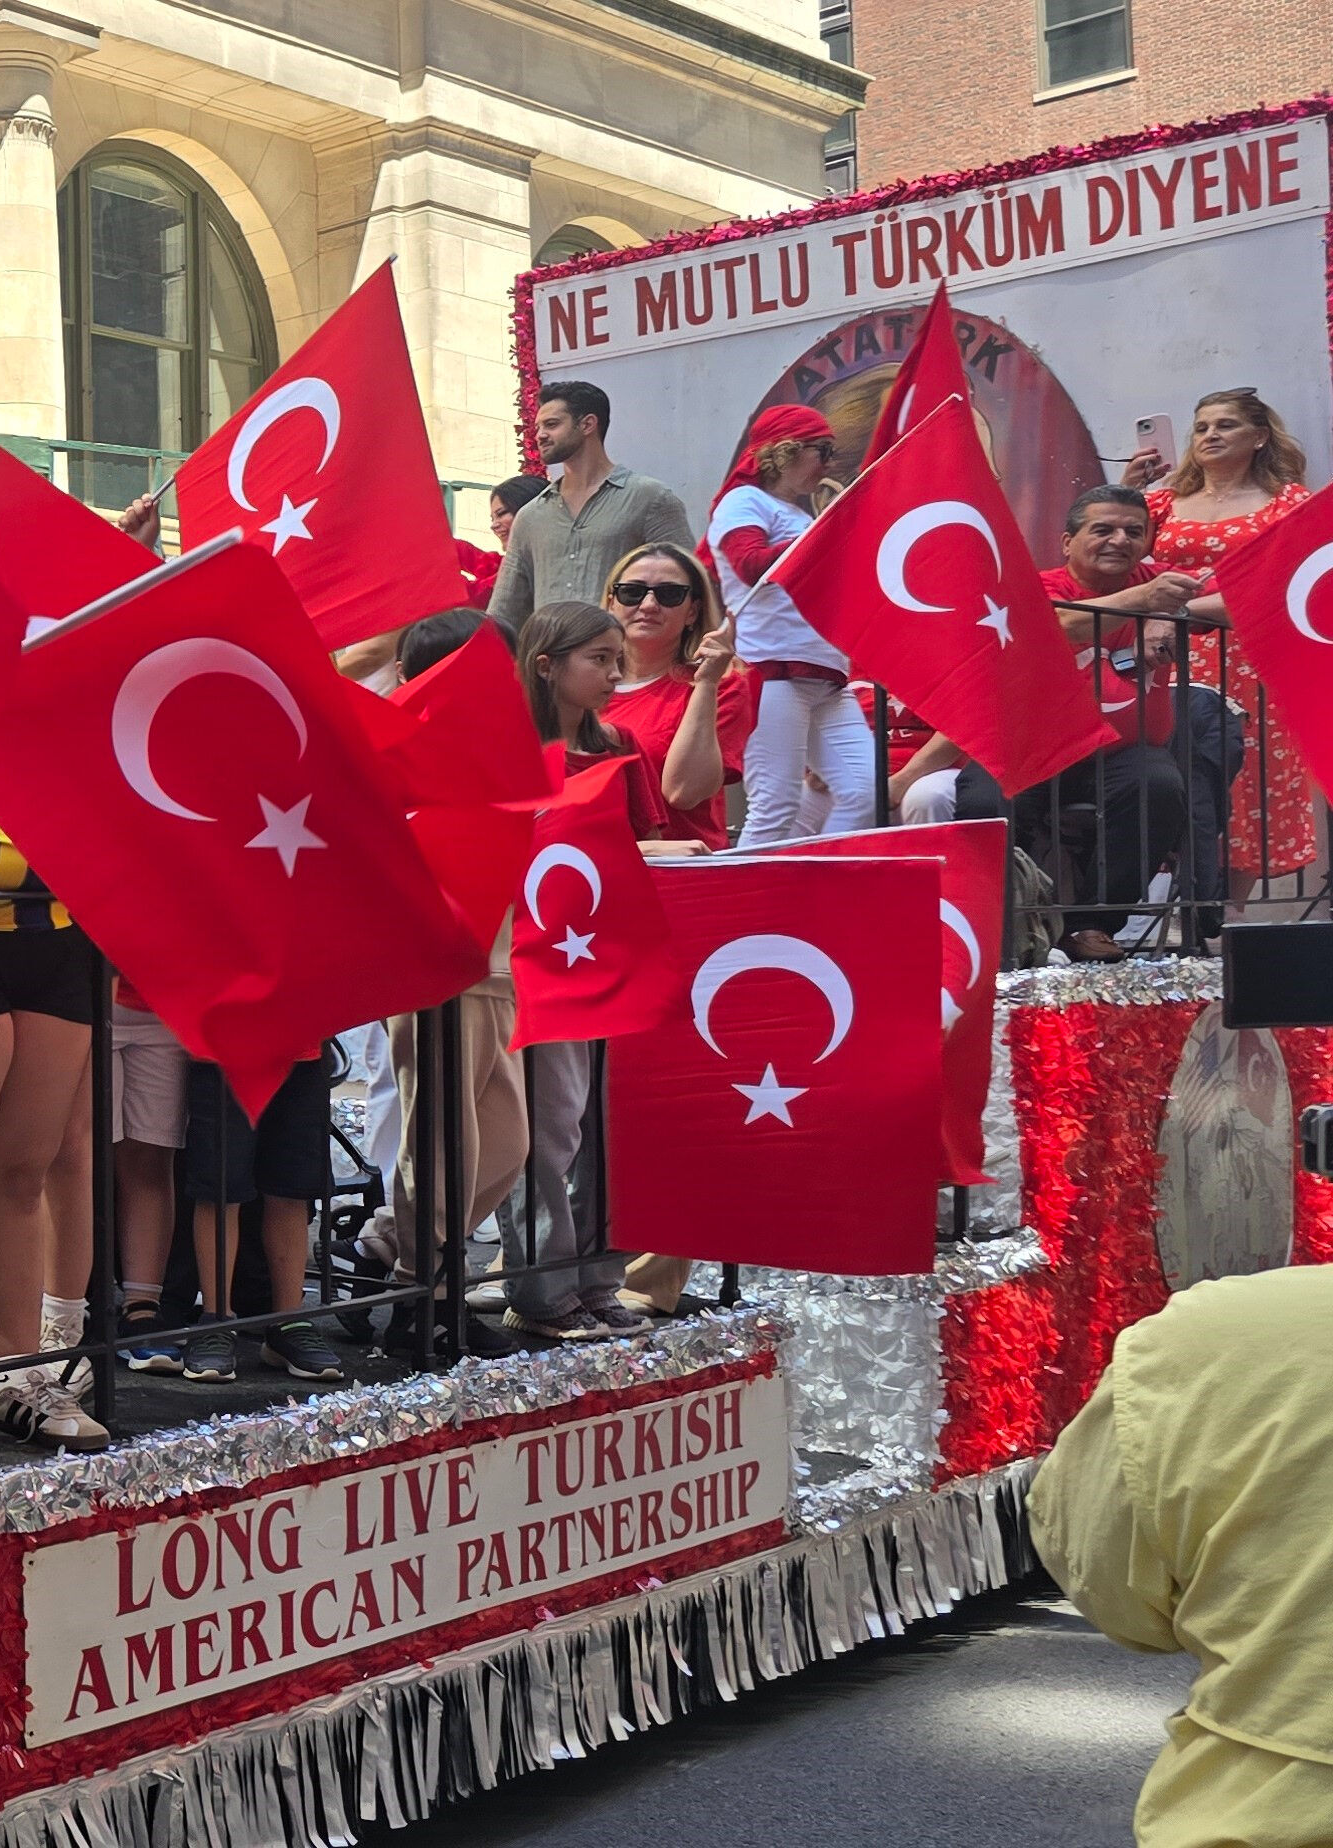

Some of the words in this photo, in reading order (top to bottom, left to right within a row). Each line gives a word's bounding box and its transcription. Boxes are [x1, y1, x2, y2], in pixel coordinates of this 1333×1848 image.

[548, 285, 609, 353] NE
[635, 242, 809, 336] MUTLU
[832, 187, 1064, 295] TÜRKÜM
[1086, 132, 1300, 246] DIYENE
[792, 314, 1016, 401] ATATRK
[63, 1553, 426, 1722] AMERICAN
[457, 1460, 760, 1603] PARTNERSHIP
[116, 1498, 302, 1617] LONG
[344, 1453, 480, 1556] LIVE
[516, 1388, 743, 1506] TURKISH
